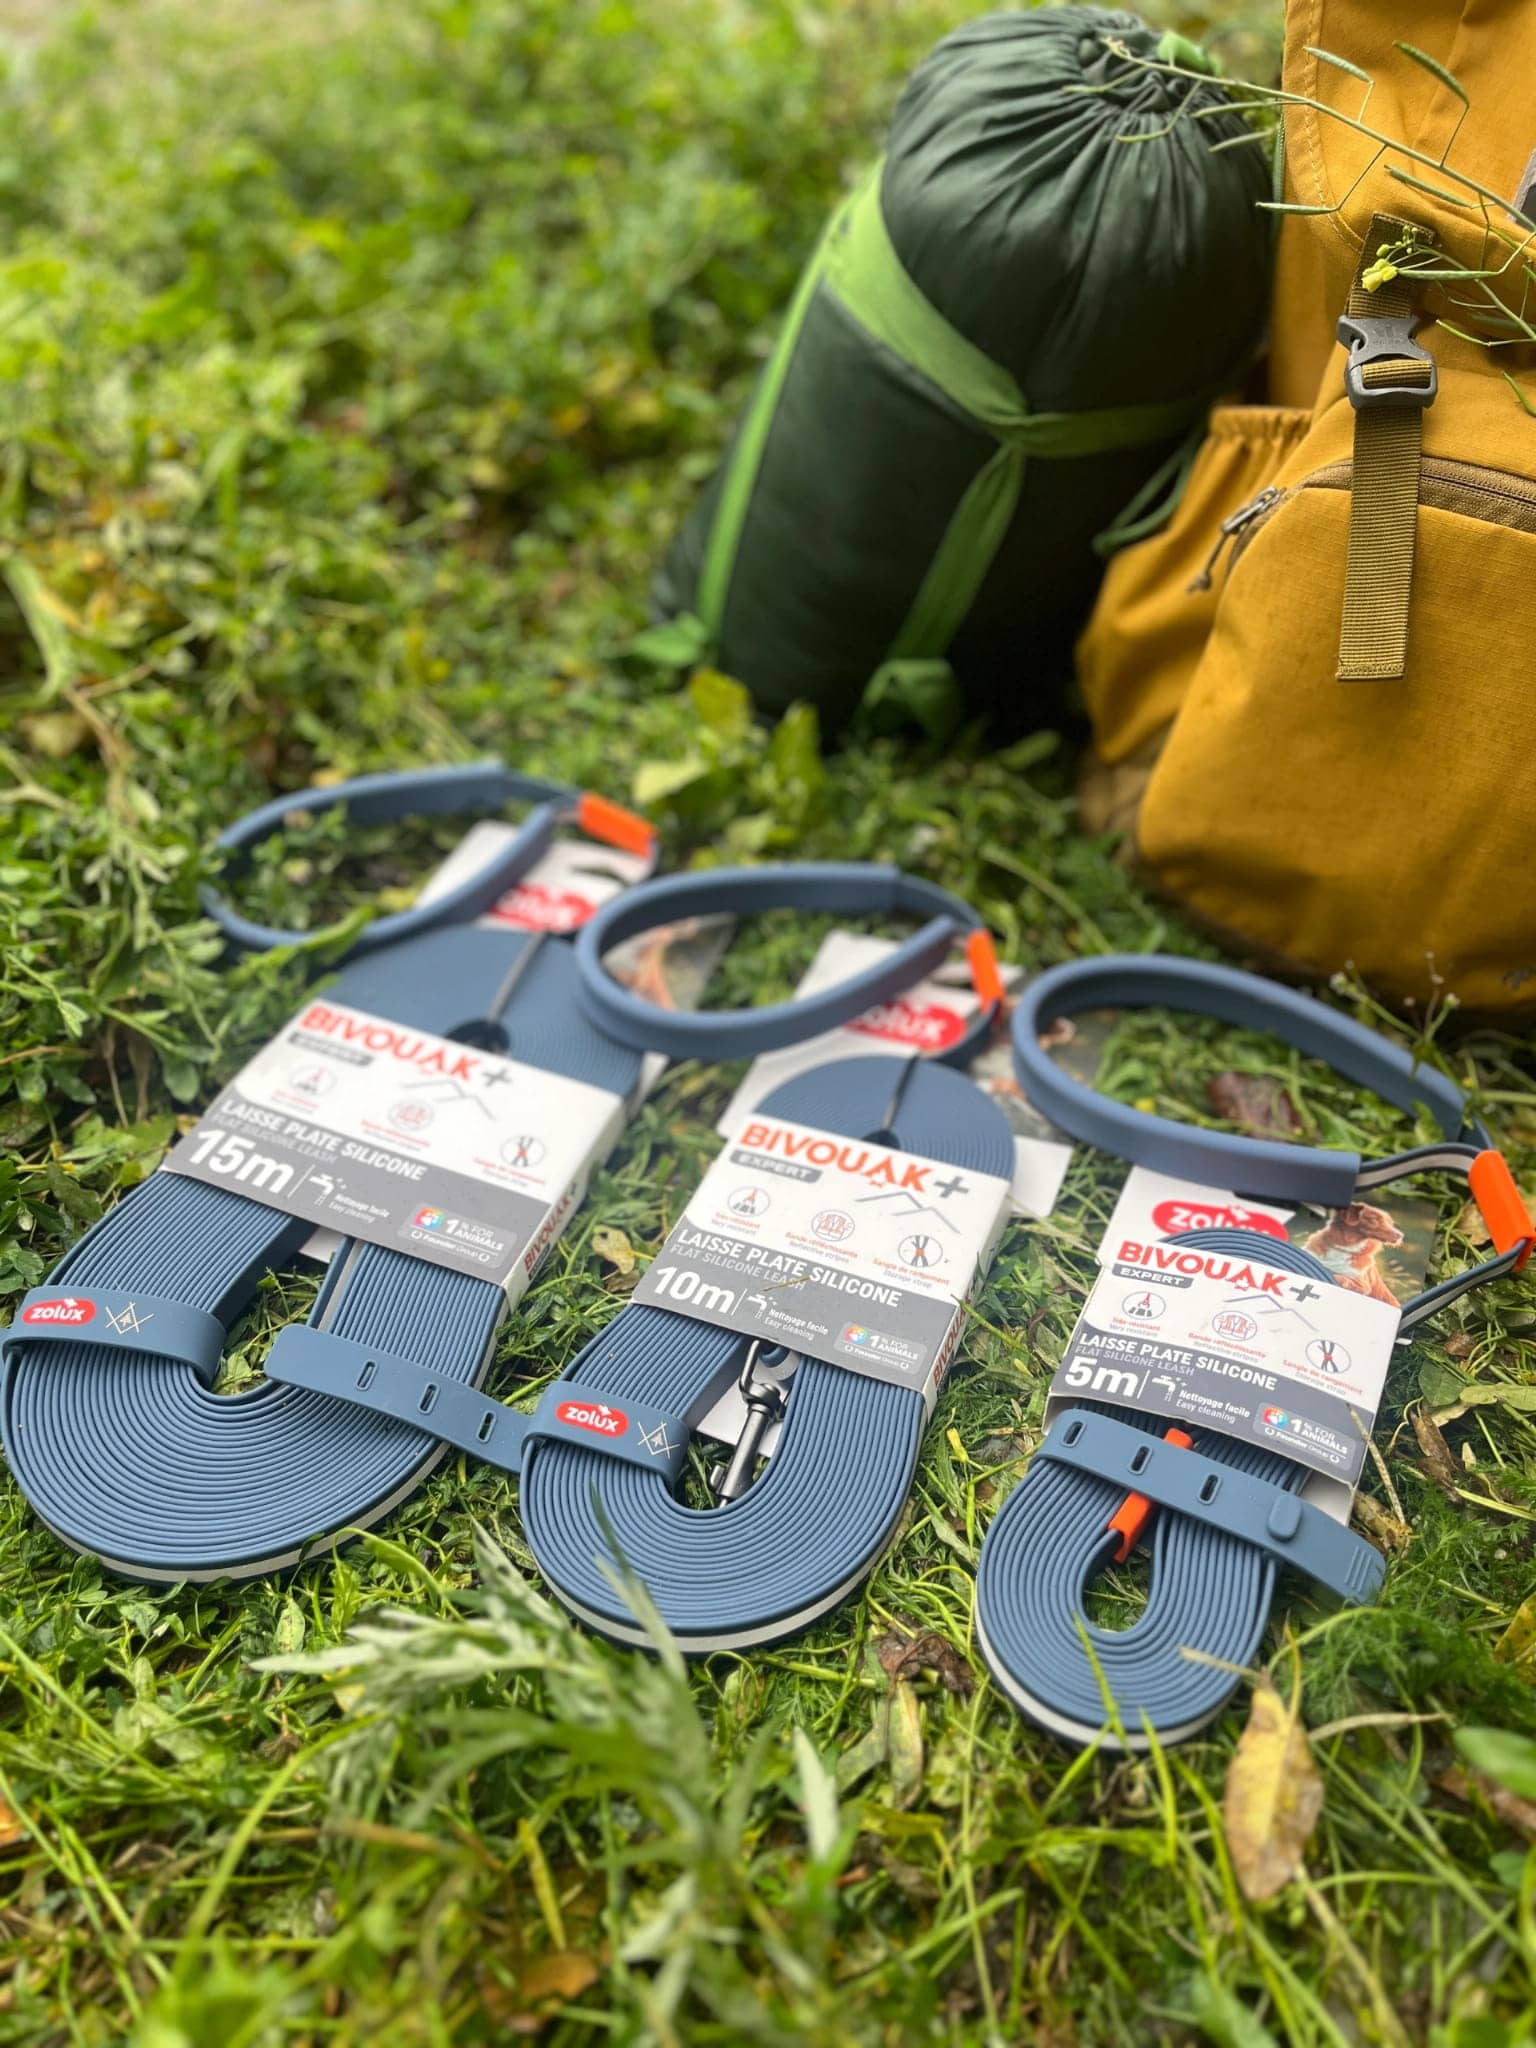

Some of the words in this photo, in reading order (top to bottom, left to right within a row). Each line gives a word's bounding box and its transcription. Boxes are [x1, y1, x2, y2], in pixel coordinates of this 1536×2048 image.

[219, 1100, 287, 1131] LAISSE
[287, 1120, 342, 1151] PLATE
[340, 1138, 428, 1182] SILICONE
[188, 1129, 295, 1195] 15m
[738, 1153, 813, 1180] EXPERT
[454, 1229, 505, 1252] ANIMALS
[669, 1243, 702, 1260] FLAT
[702, 1250, 764, 1278] SILICONE
[677, 1228, 745, 1259] LAISSE
[746, 1250, 809, 1276] PLATE
[808, 1265, 903, 1308] SILICONE
[653, 1265, 736, 1315] 10m
[1119, 1267, 1185, 1287] EXPERT
[30, 1304, 86, 1321] zolux
[768, 1308, 806, 1329] Nettoyage
[806, 1320, 830, 1336] facile
[763, 1316, 781, 1330] Easy
[781, 1323, 816, 1342] cleaning
[877, 1343, 919, 1361] ANIMALS
[1074, 1345, 1102, 1359] FLAT
[1102, 1350, 1156, 1369] SILICONE
[1157, 1359, 1195, 1377] LEASH
[1079, 1332, 1138, 1354] LAISSE
[1140, 1341, 1193, 1366] PLATE
[1195, 1356, 1279, 1392] SILICONE
[1064, 1355, 1139, 1398] 5m
[1175, 1398, 1197, 1414] Easy
[1197, 1405, 1237, 1425] cleaning
[1178, 1389, 1224, 1411] Nettoyage
[1224, 1401, 1251, 1419] facile
[565, 1407, 620, 1433] zolux
[1312, 1426, 1336, 1441] FOR
[1300, 1430, 1348, 1455] ANIMALS
